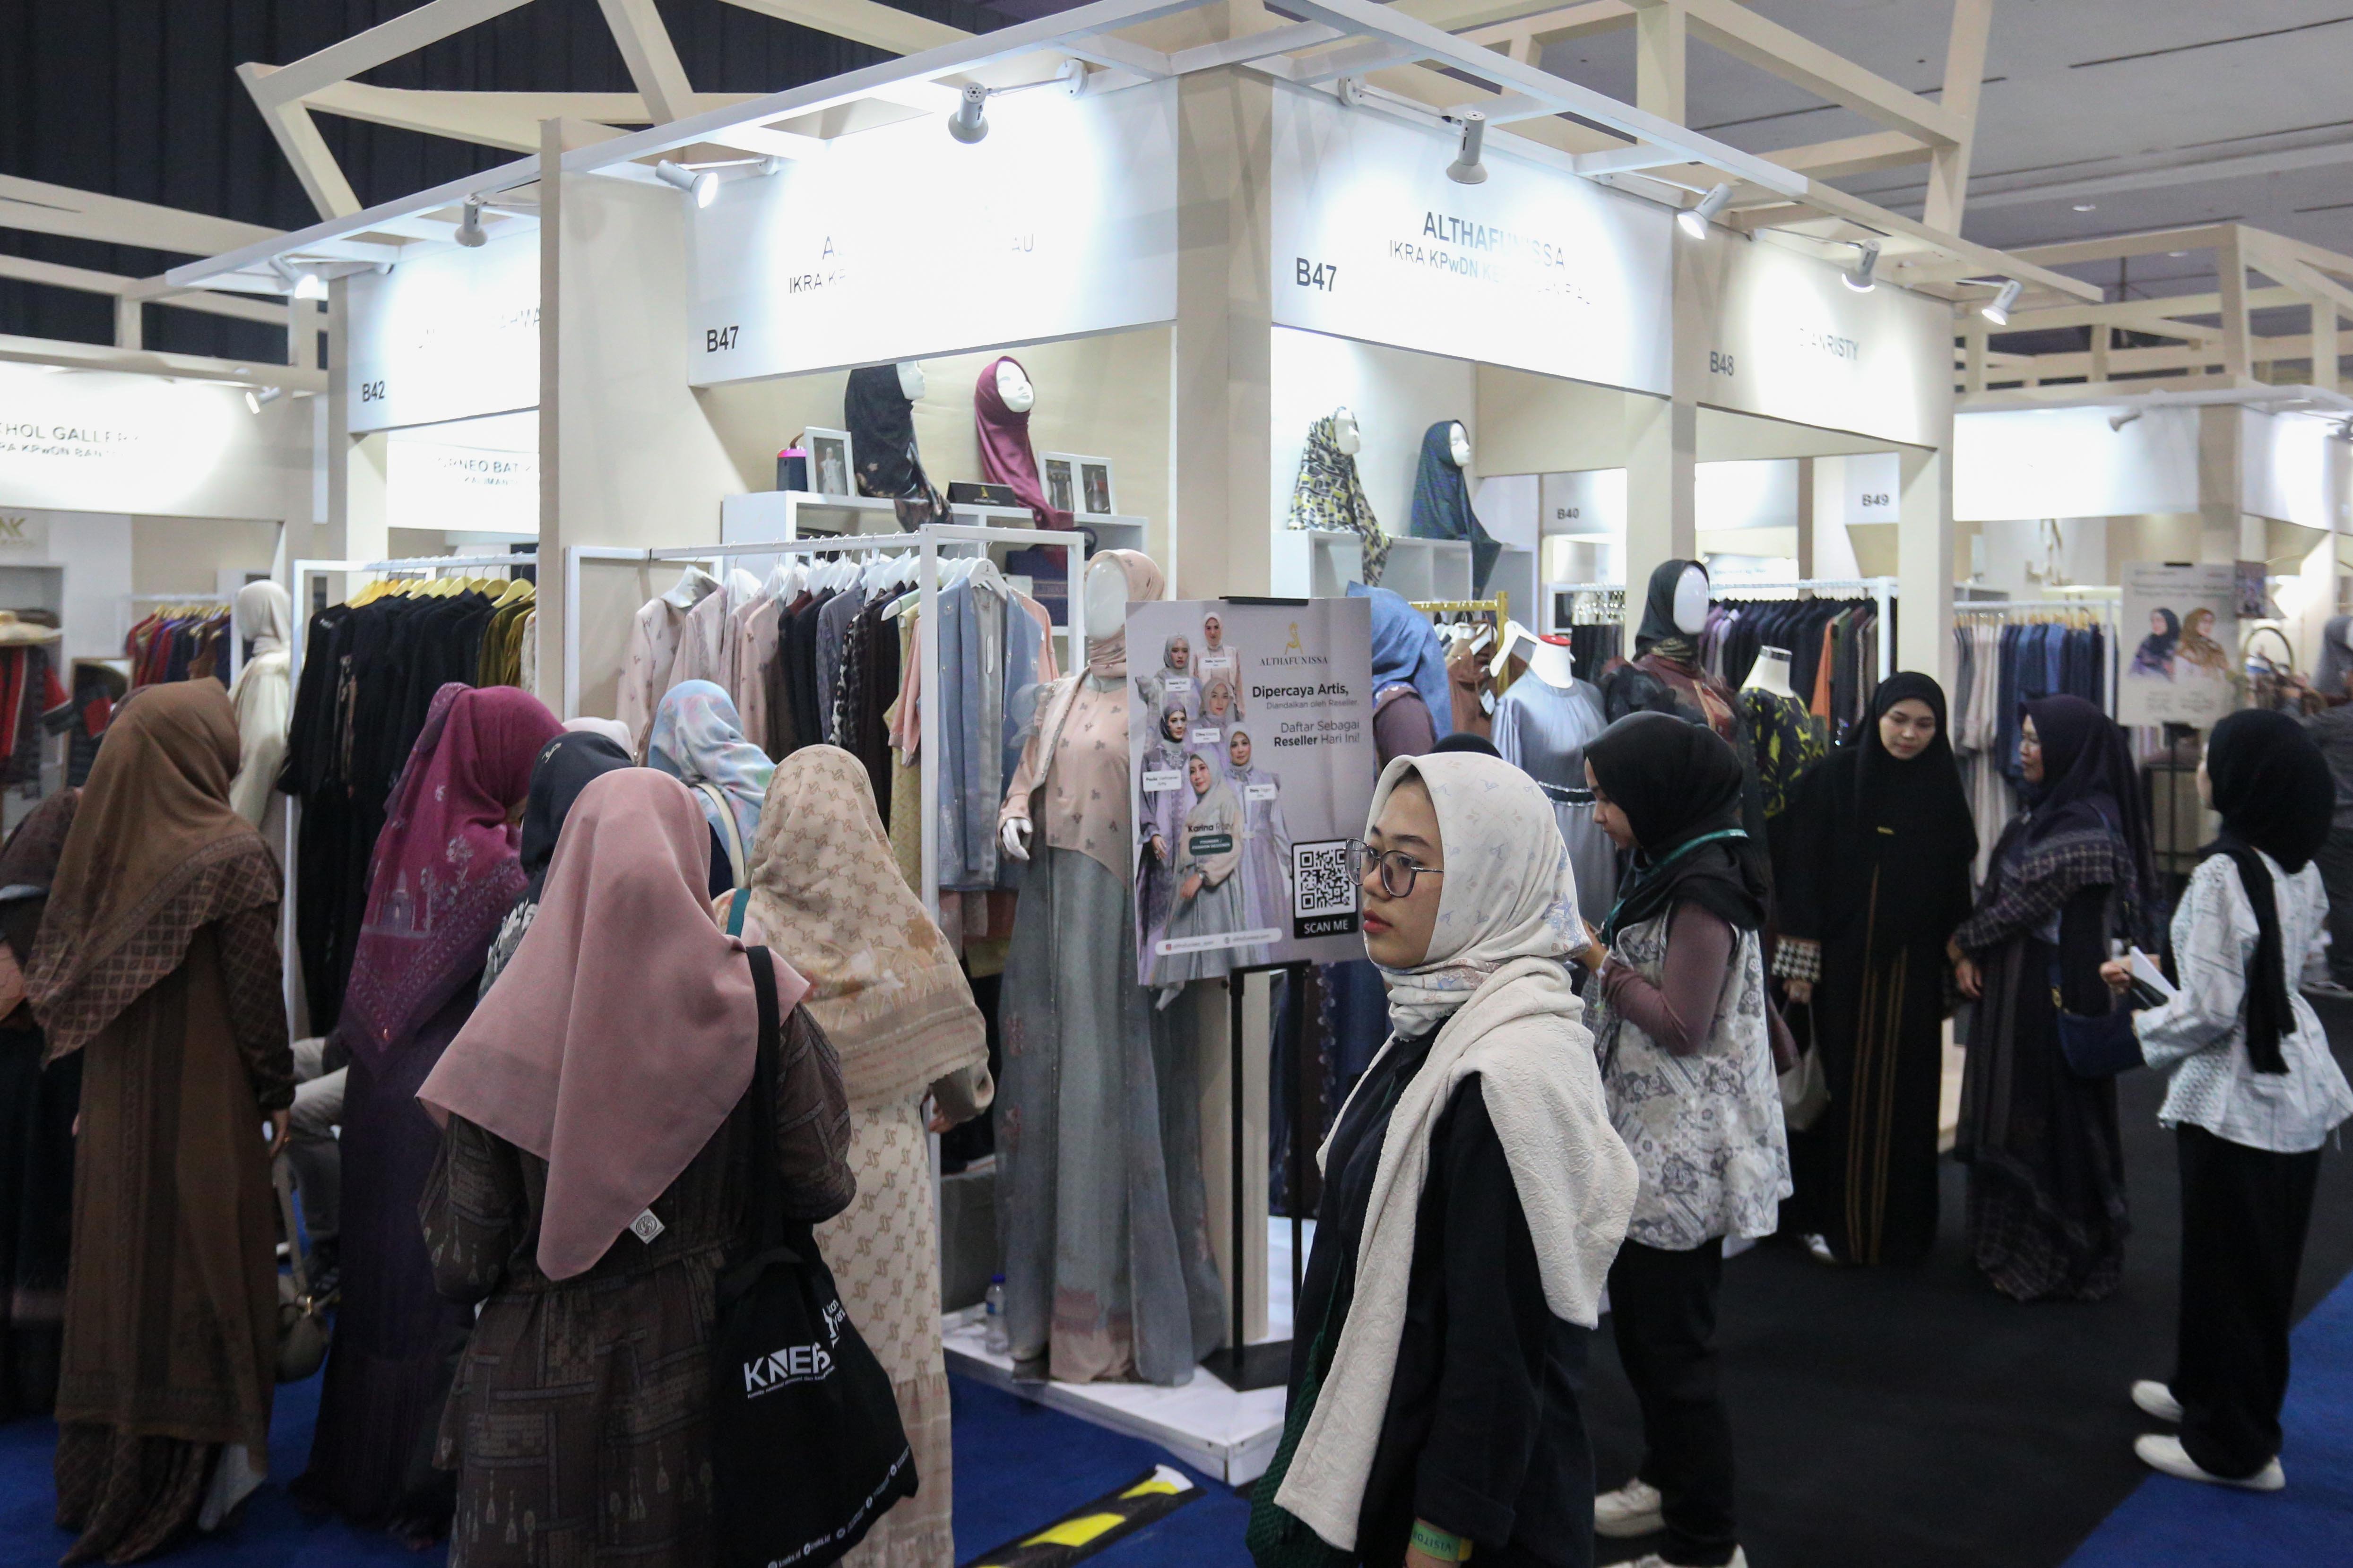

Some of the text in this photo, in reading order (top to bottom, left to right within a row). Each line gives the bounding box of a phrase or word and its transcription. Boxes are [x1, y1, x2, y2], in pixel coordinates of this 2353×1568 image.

[1390, 240, 1425, 265] IKRA
[1429, 249, 1478, 278] KPwDN
[789, 273, 823, 293] IKRA
[1297, 257, 1337, 292] B47
[707, 326, 739, 353] B47
[1710, 351, 1734, 376] B48
[363, 380, 385, 403] B42
[1557, 508, 1579, 519] B40
[1260, 656, 1328, 666] ALTHAFUNISSA
[1253, 683, 1349, 699] Dipercaya Artis,
[1281, 719, 1359, 733] Daftar Sebagai
[1274, 735, 1317, 747] Reseller
[1321, 734, 1342, 744] Hari
[1304, 919, 1348, 934] SCAN ME
